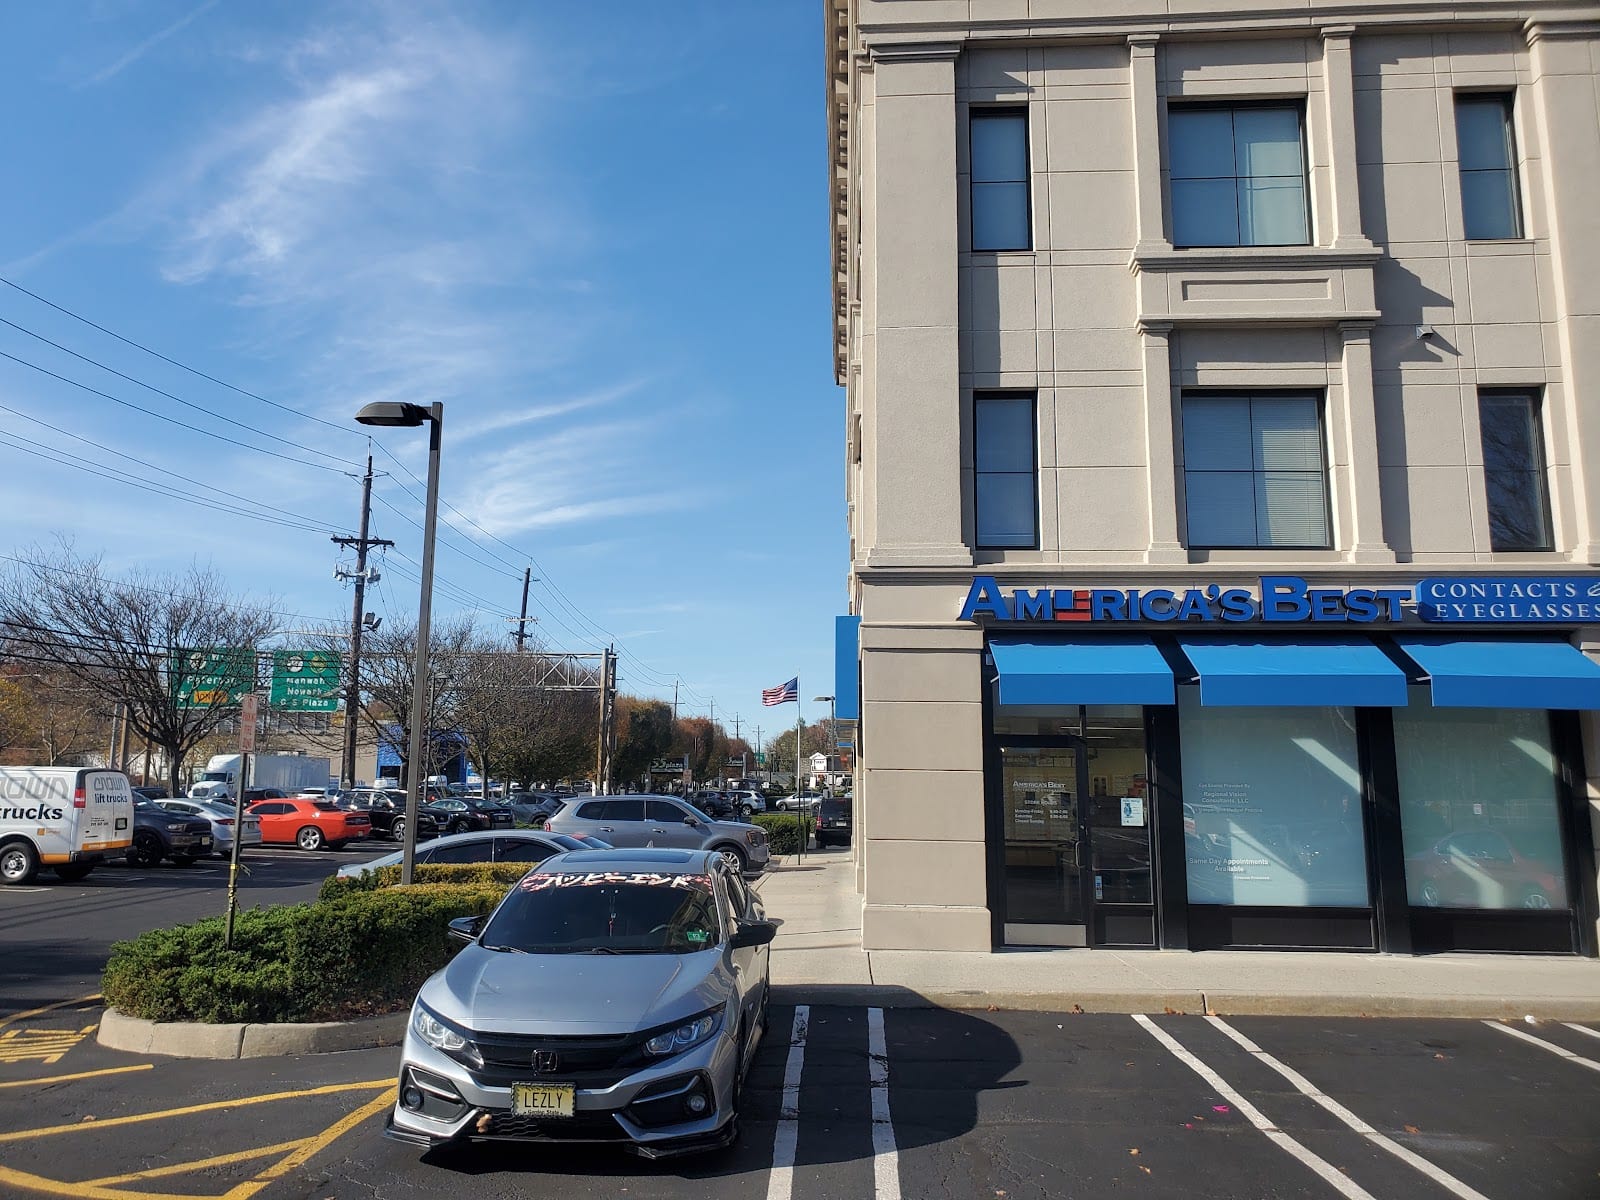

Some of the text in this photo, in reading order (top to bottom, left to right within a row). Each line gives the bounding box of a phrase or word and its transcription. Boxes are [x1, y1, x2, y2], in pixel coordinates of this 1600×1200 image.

[1431, 583, 1576, 598] CONTACTS
[1258, 575, 1412, 622] BEST
[302, 698, 329, 707] Plaza
[95, 793, 128, 803] lift trucks
[1209, 858, 1221, 866] Day
[1223, 858, 1269, 866] Appointments
[524, 1092, 563, 1108] LEZLY
